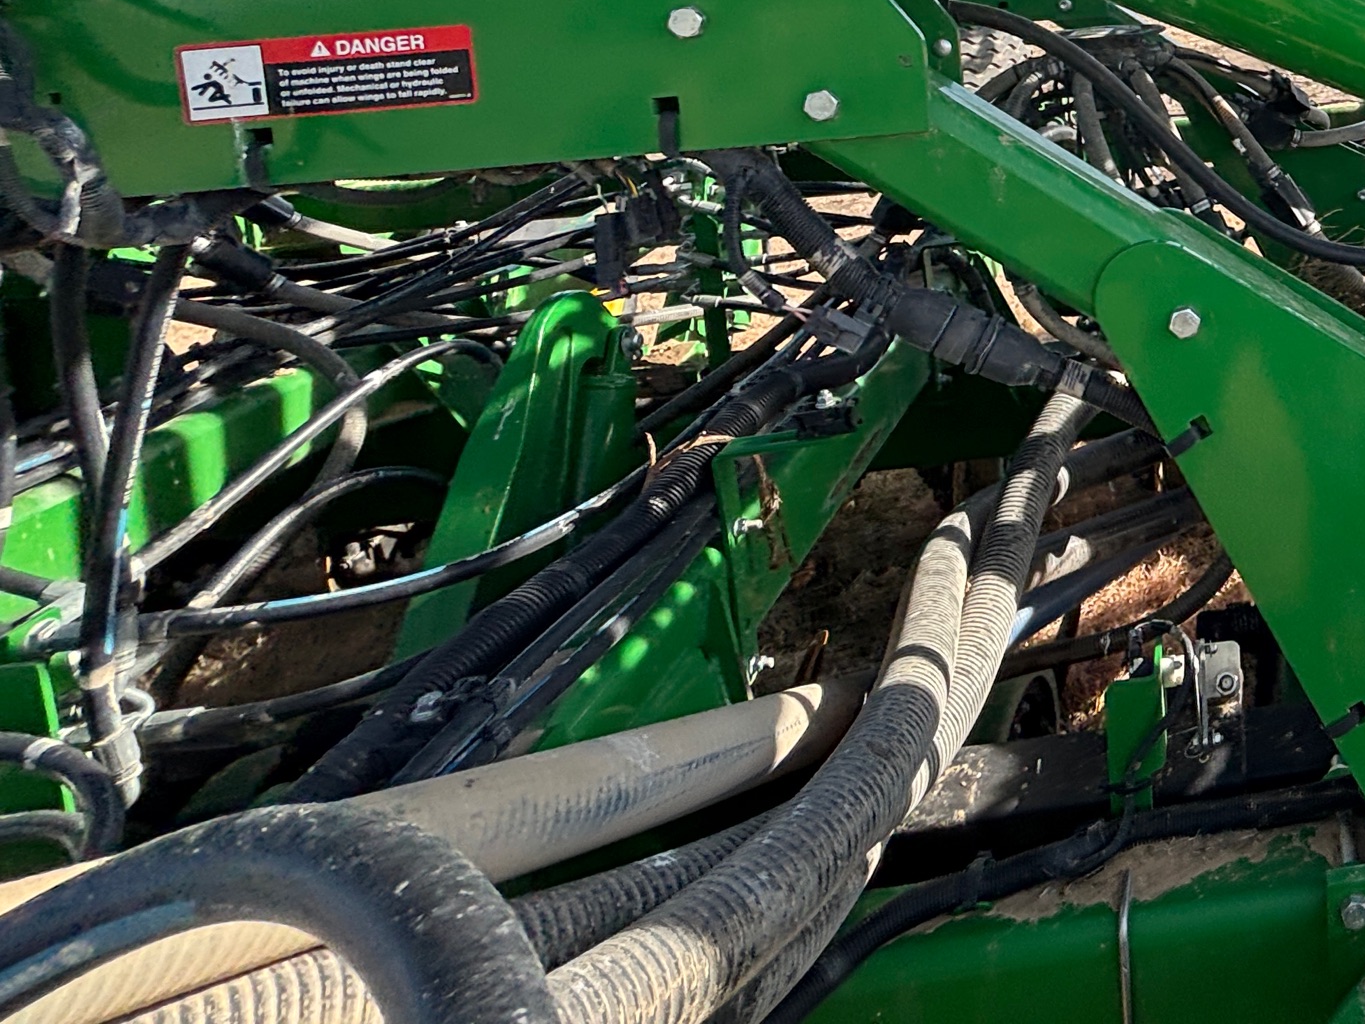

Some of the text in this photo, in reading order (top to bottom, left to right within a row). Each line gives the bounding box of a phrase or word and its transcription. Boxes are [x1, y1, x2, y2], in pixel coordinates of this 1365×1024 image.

[336, 35, 425, 56] DANGER
[291, 67, 316, 75] avoid
[318, 66, 344, 74] injury
[359, 62, 384, 71] death
[386, 60, 411, 68] stand
[279, 79, 289, 87] of
[290, 77, 329, 85] machine
[357, 73, 385, 81] wings
[430, 66, 459, 74] folded
[336, 82, 388, 92] Mechanical
[401, 78, 444, 88] hydraulic
[282, 99, 311, 107] failure
[357, 94, 385, 102] wings
[398, 90, 412, 98] fall
